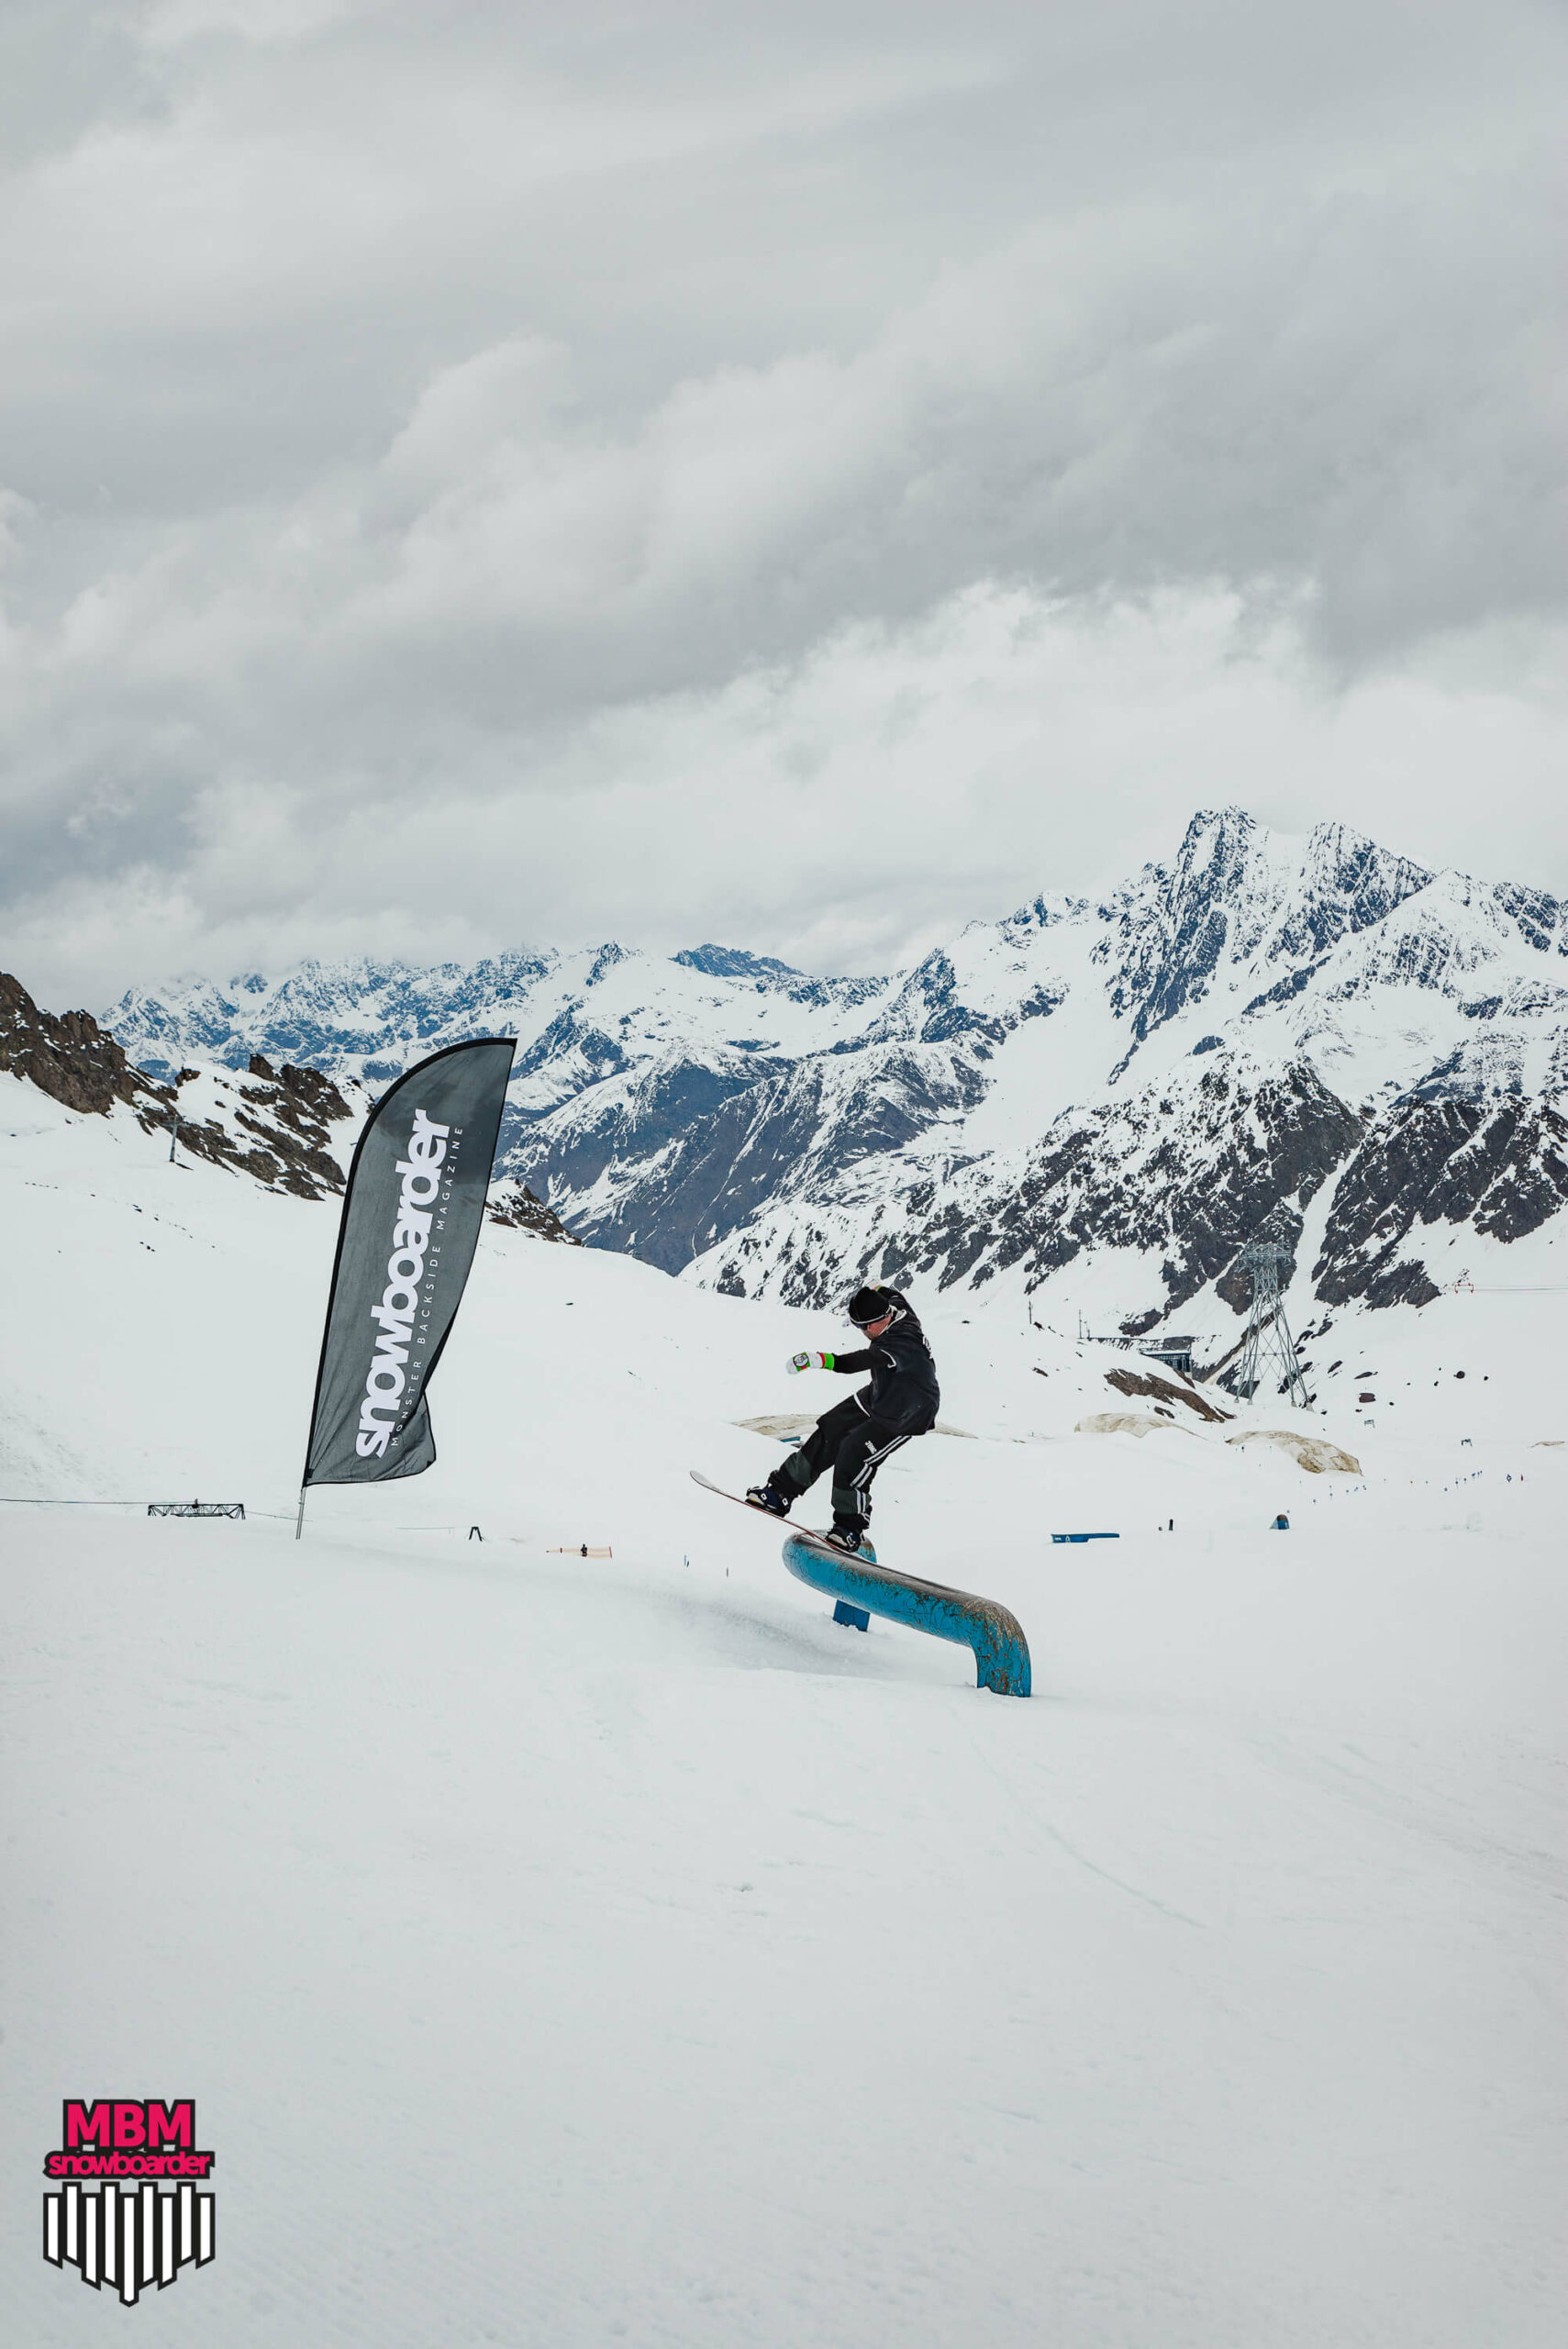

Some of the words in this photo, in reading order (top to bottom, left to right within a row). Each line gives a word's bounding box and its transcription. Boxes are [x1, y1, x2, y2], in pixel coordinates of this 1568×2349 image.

[355, 1108, 450, 1458] snowboarder
[391, 1361, 422, 1446] MONSTER
[417, 1246, 440, 1344] BACKSIDE
[436, 1127, 463, 1230] MAGAZINE
